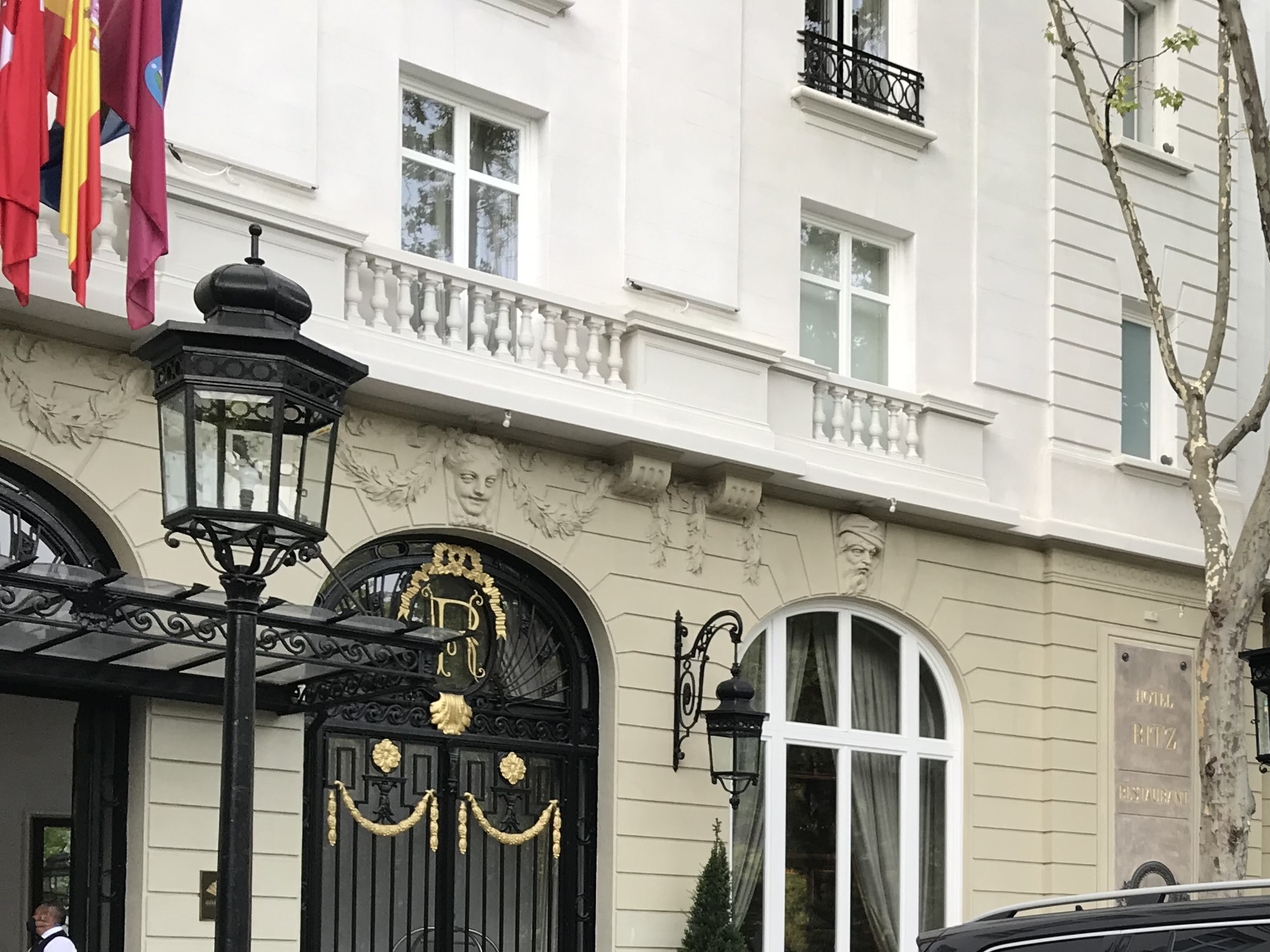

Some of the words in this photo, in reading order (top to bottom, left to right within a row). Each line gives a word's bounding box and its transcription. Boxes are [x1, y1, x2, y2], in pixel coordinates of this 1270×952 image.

[1136, 689, 1174, 709] HOTEL
[1132, 723, 1178, 750] RITZ
[1118, 784, 1188, 805] RESTAURANT
